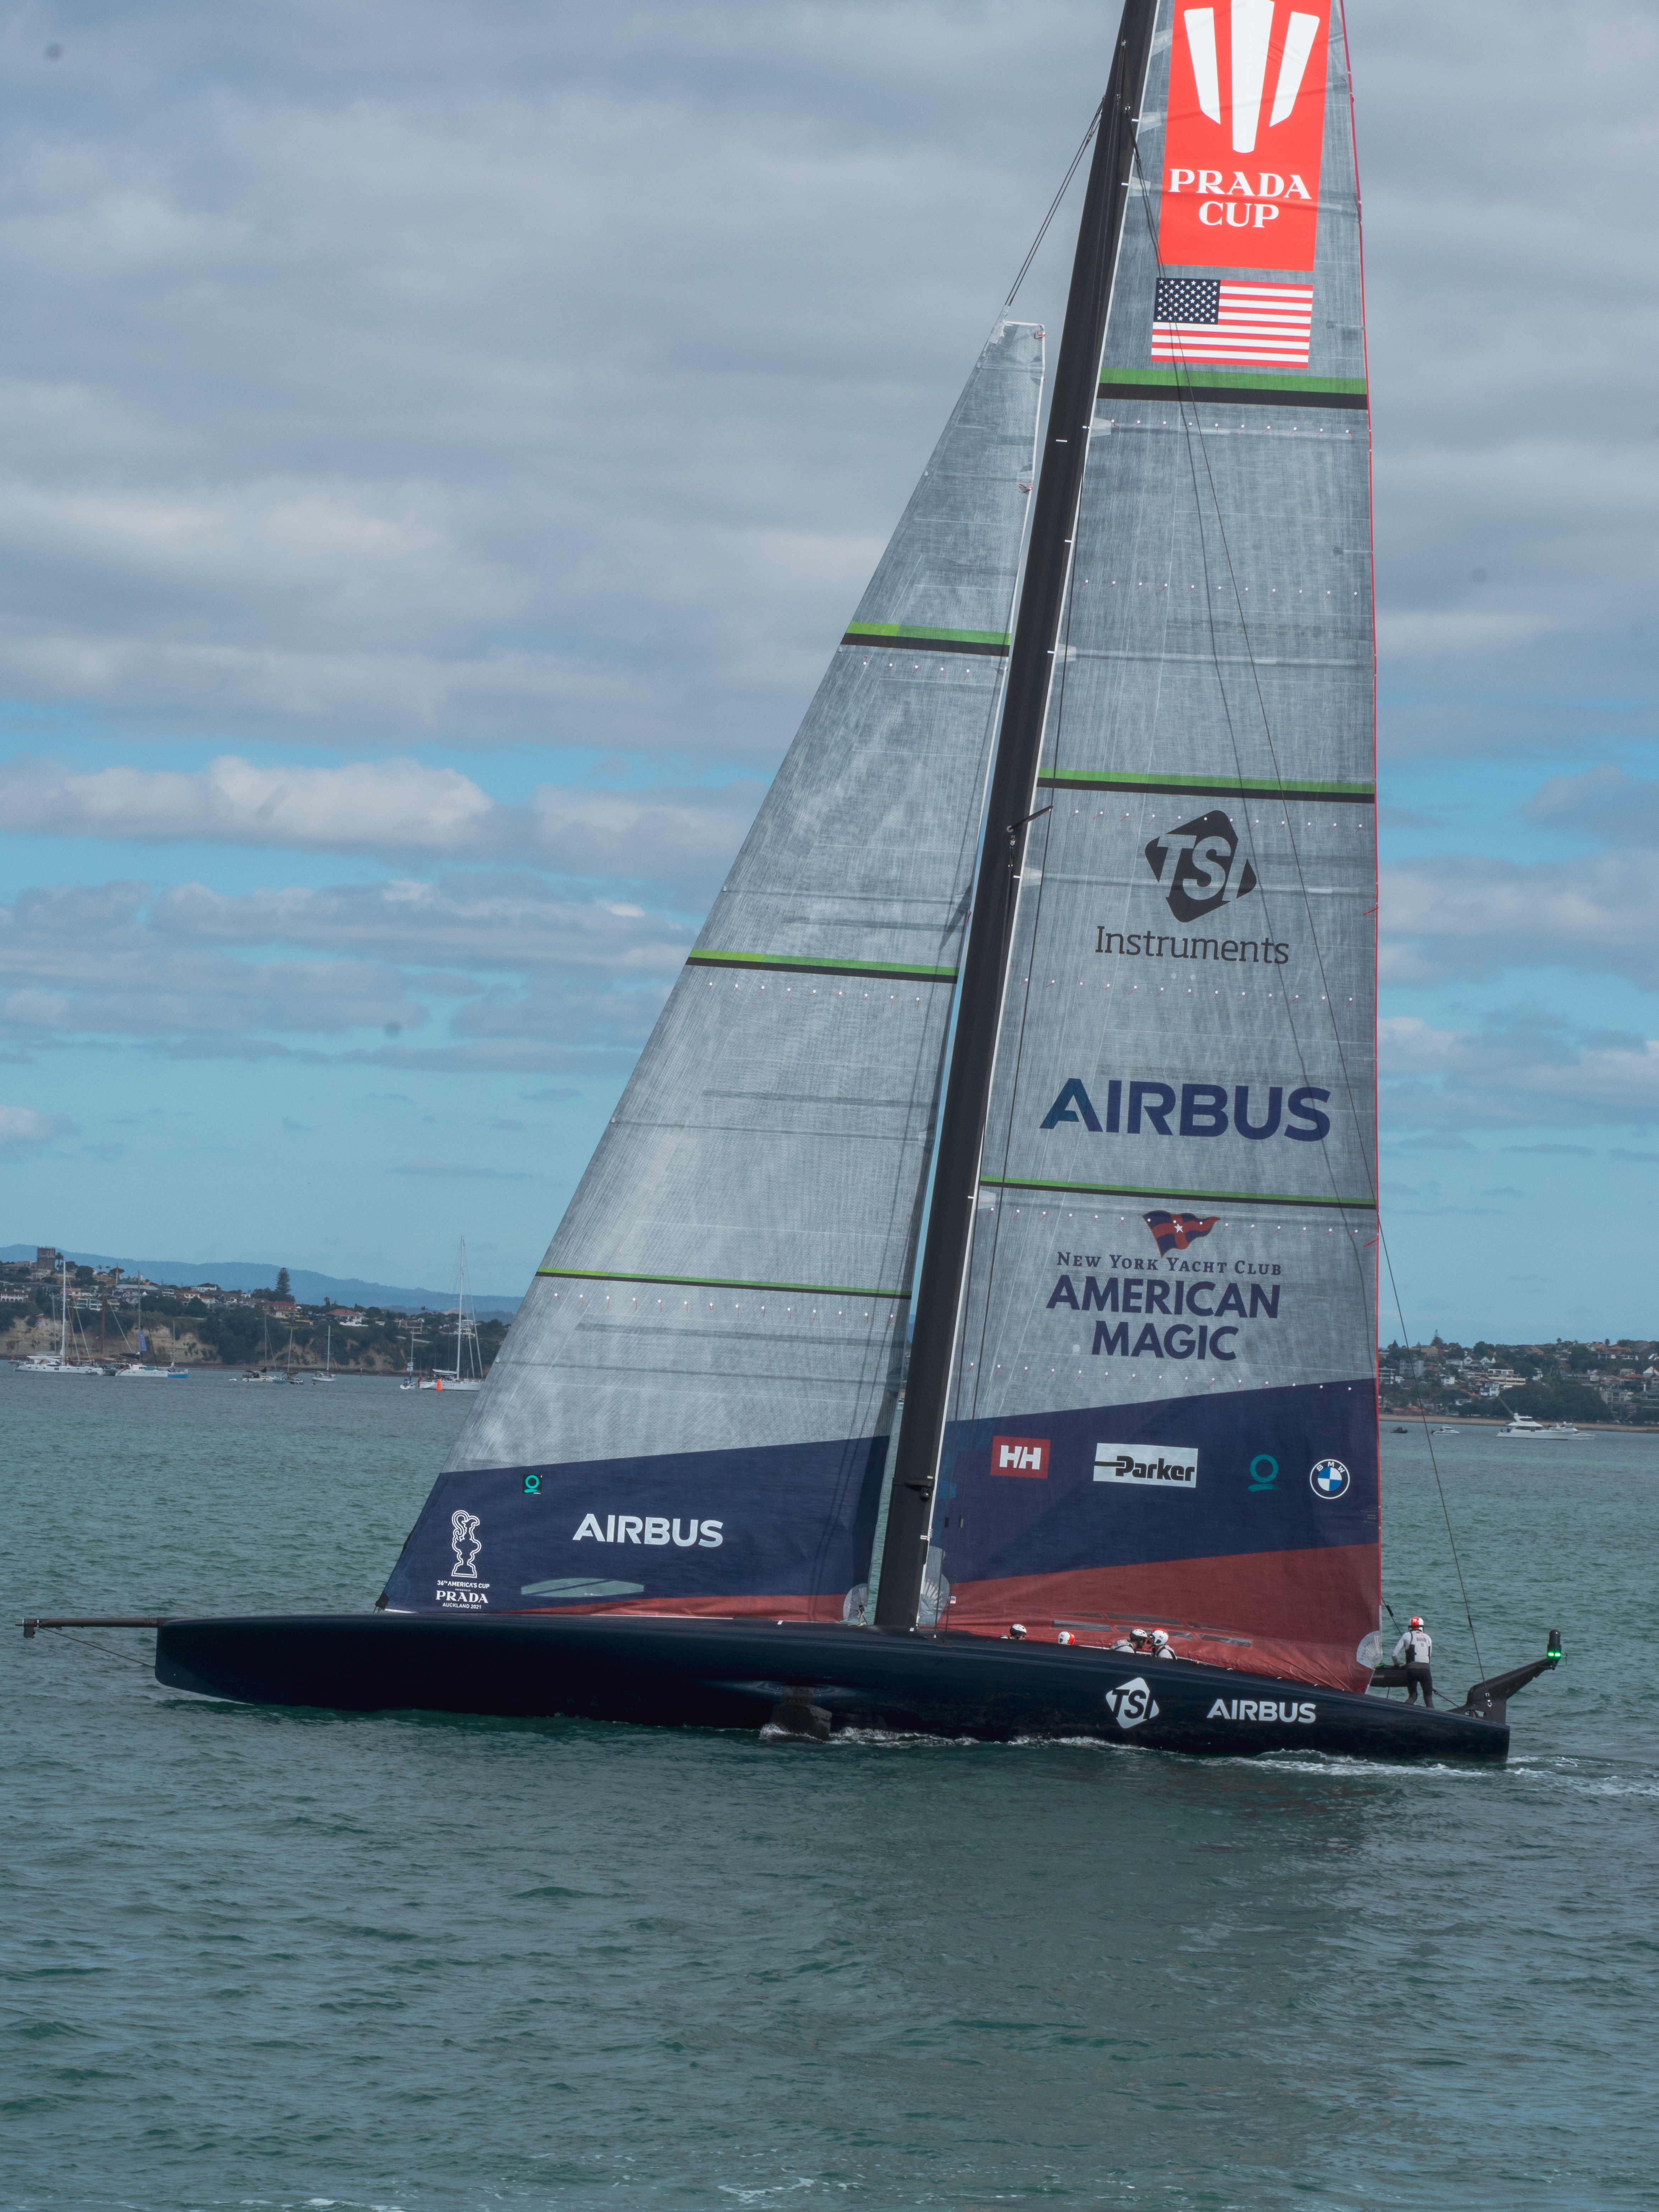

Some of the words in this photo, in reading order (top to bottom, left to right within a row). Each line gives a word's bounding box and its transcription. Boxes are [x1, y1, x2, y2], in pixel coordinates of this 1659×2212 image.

[1169, 169, 1312, 199] PRADA
[1198, 201, 1279, 228] CUP
[1157, 834, 1249, 903] TSI
[1095, 926, 1289, 964] Instruments
[1039, 1078, 1331, 1141] AIRBUS
[1046, 1274, 1280, 1319] AMERICAN
[1091, 1320, 1239, 1360] MAGIC
[1115, 1456, 1195, 1482] Parker
[1316, 1461, 1345, 1473] BMW
[572, 1513, 723, 1547] AIRBUS
[436, 1590, 489, 1603] PRADA
[1111, 1689, 1152, 1719] TSI
[1207, 1699, 1316, 1723] AIRBUS
